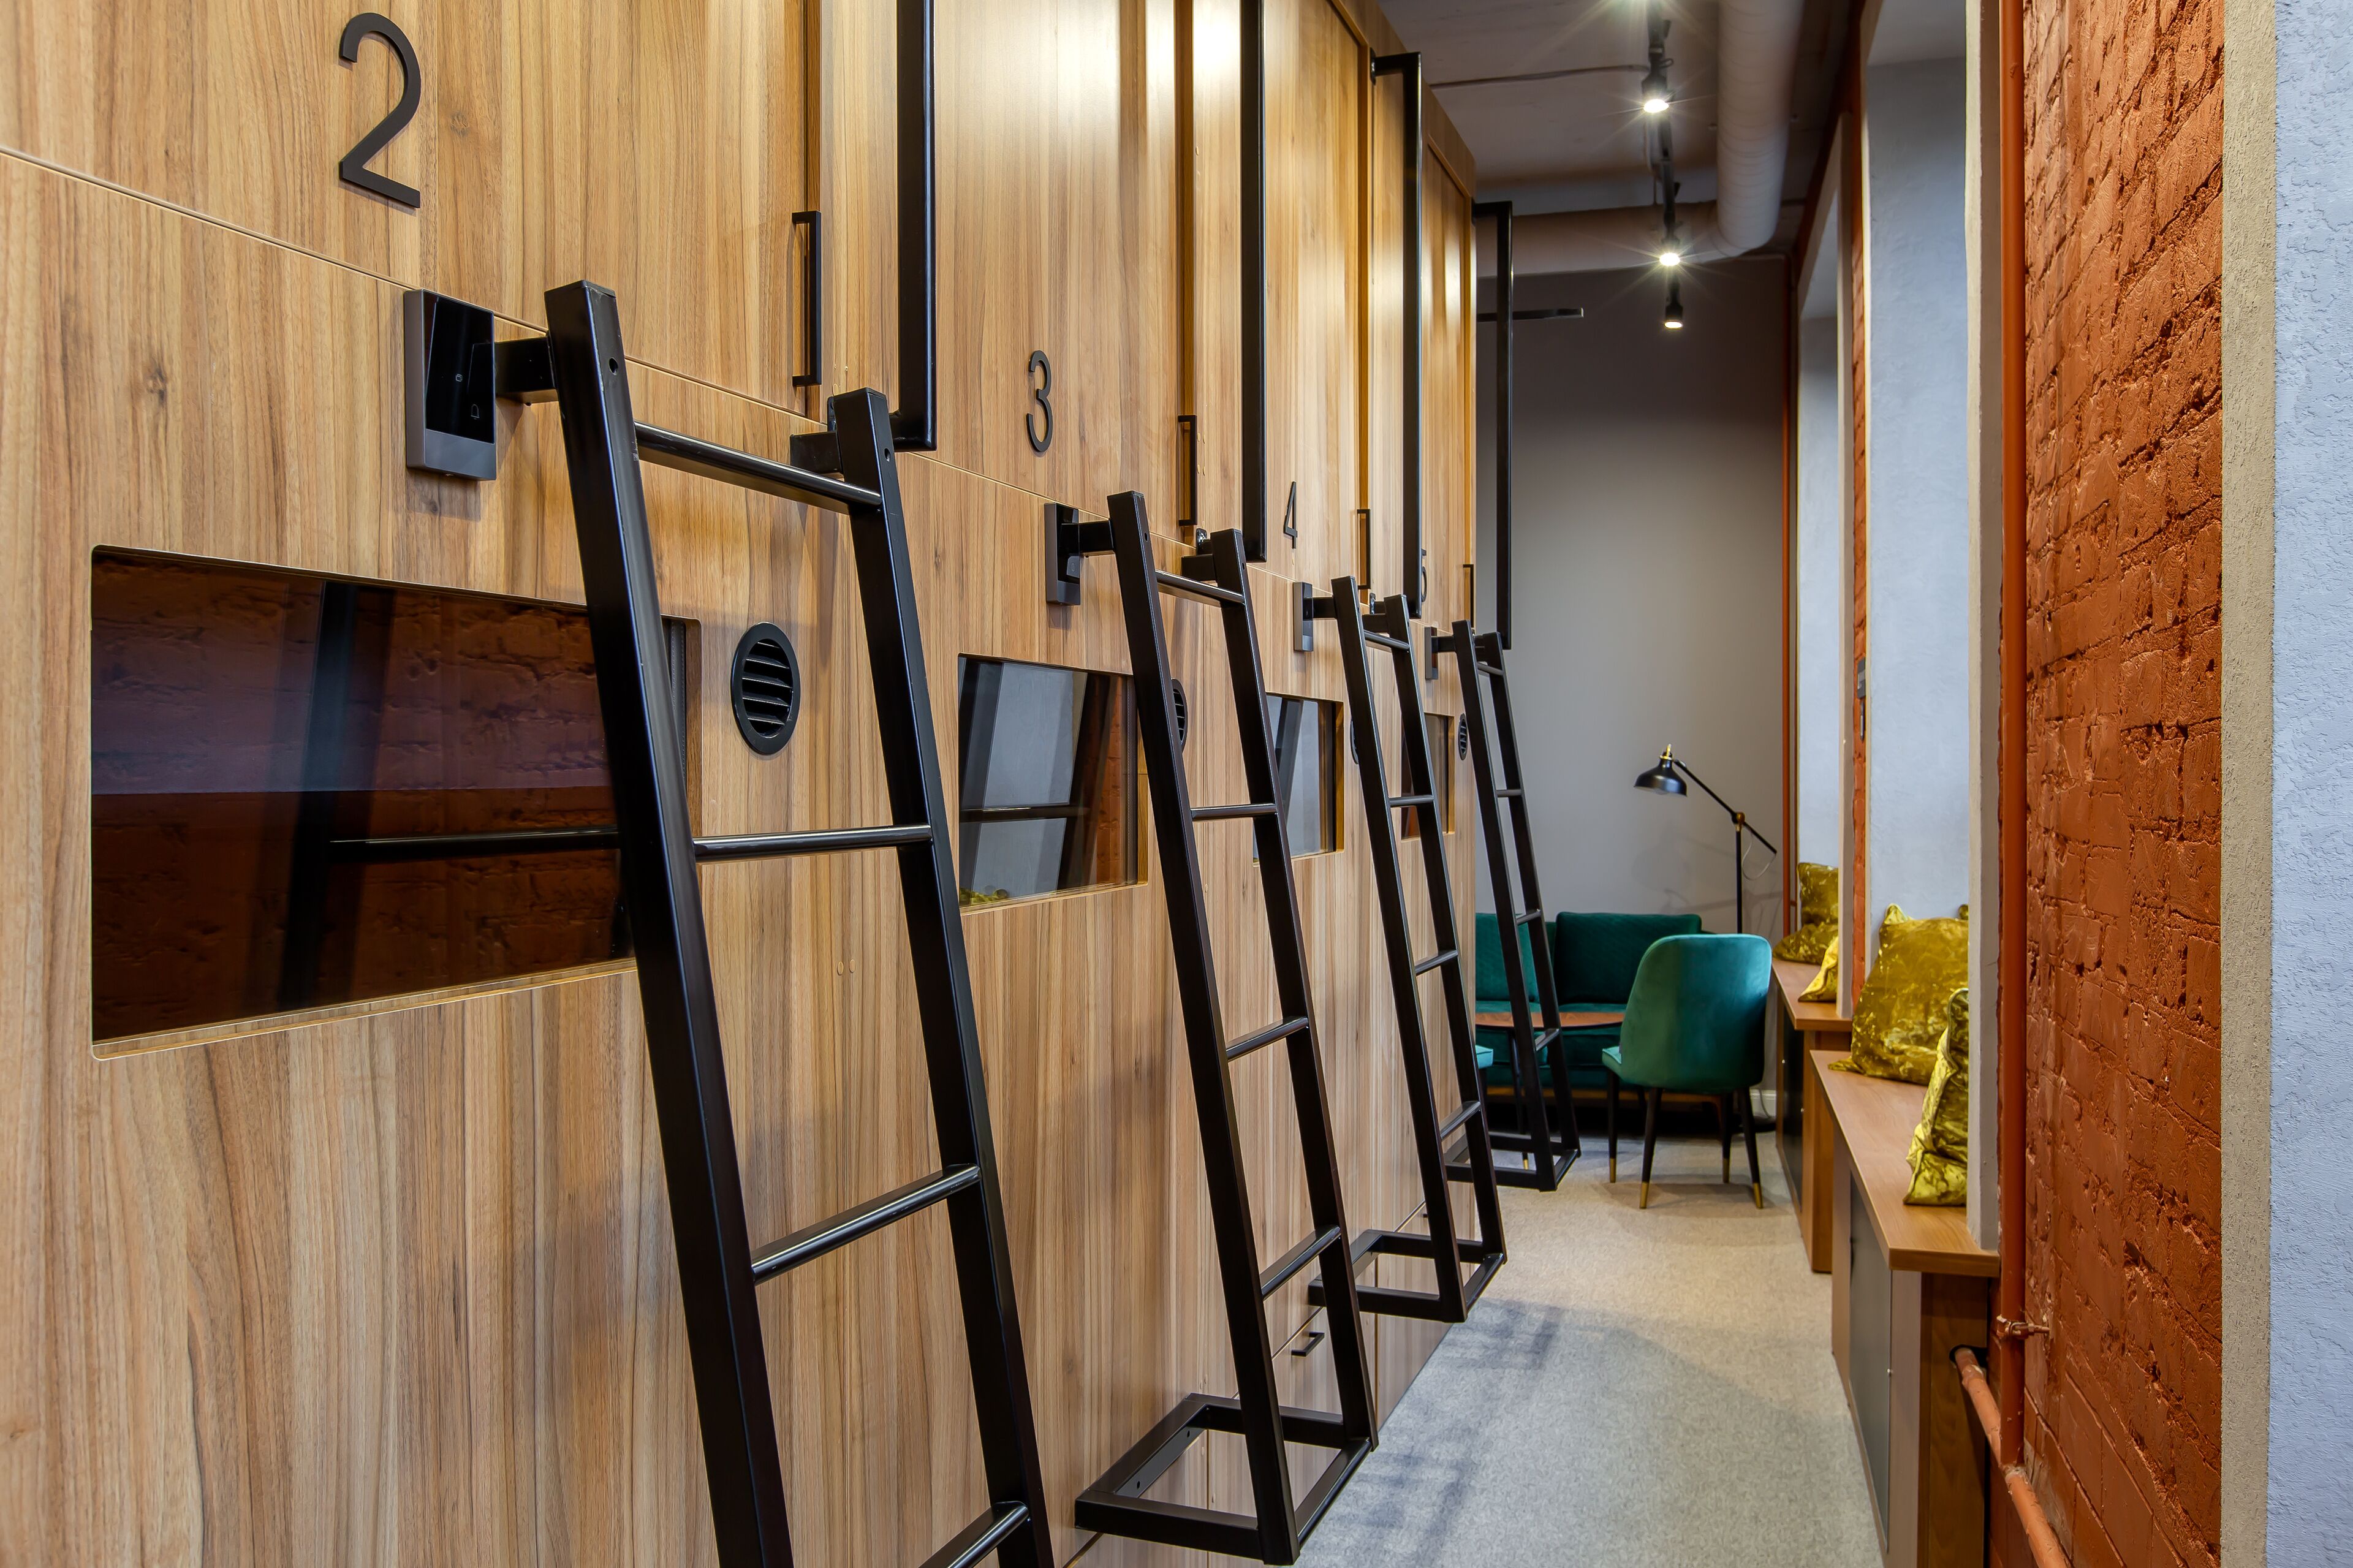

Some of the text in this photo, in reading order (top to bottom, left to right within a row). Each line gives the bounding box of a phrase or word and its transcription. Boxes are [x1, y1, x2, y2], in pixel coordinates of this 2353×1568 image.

[339, 12, 421, 208] 2
[1026, 350, 1053, 452] 3
[1283, 481, 1298, 549] 4
